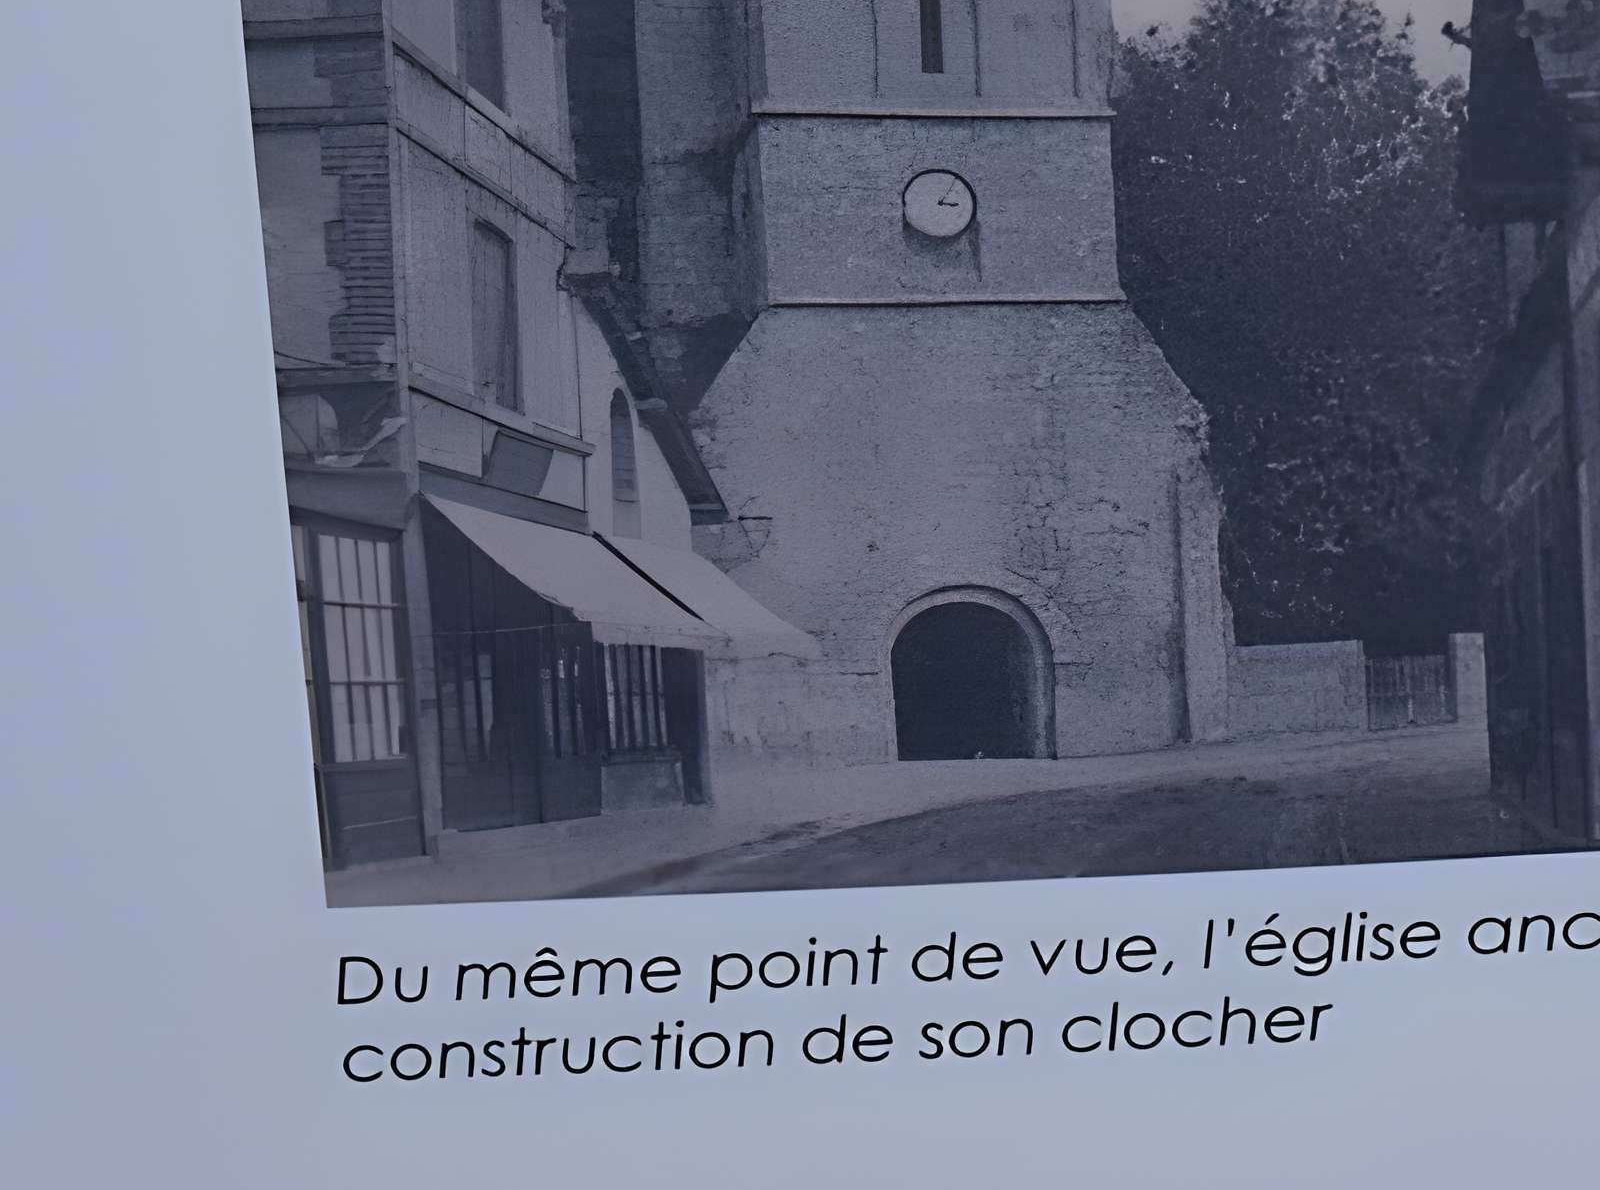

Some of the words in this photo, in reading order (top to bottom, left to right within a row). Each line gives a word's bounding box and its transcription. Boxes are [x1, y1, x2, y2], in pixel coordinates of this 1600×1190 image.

[338, 957, 428, 1004] Du
[456, 946, 681, 1001] même
[710, 935, 888, 1003] point
[912, 932, 1003, 982] de
[1031, 936, 1173, 975] vue,
[1204, 912, 1440, 976] l'église
[343, 1020, 773, 1083] construction
[803, 1014, 893, 1064] de
[919, 1019, 1033, 1060] son
[1062, 996, 1333, 1052] clocher
